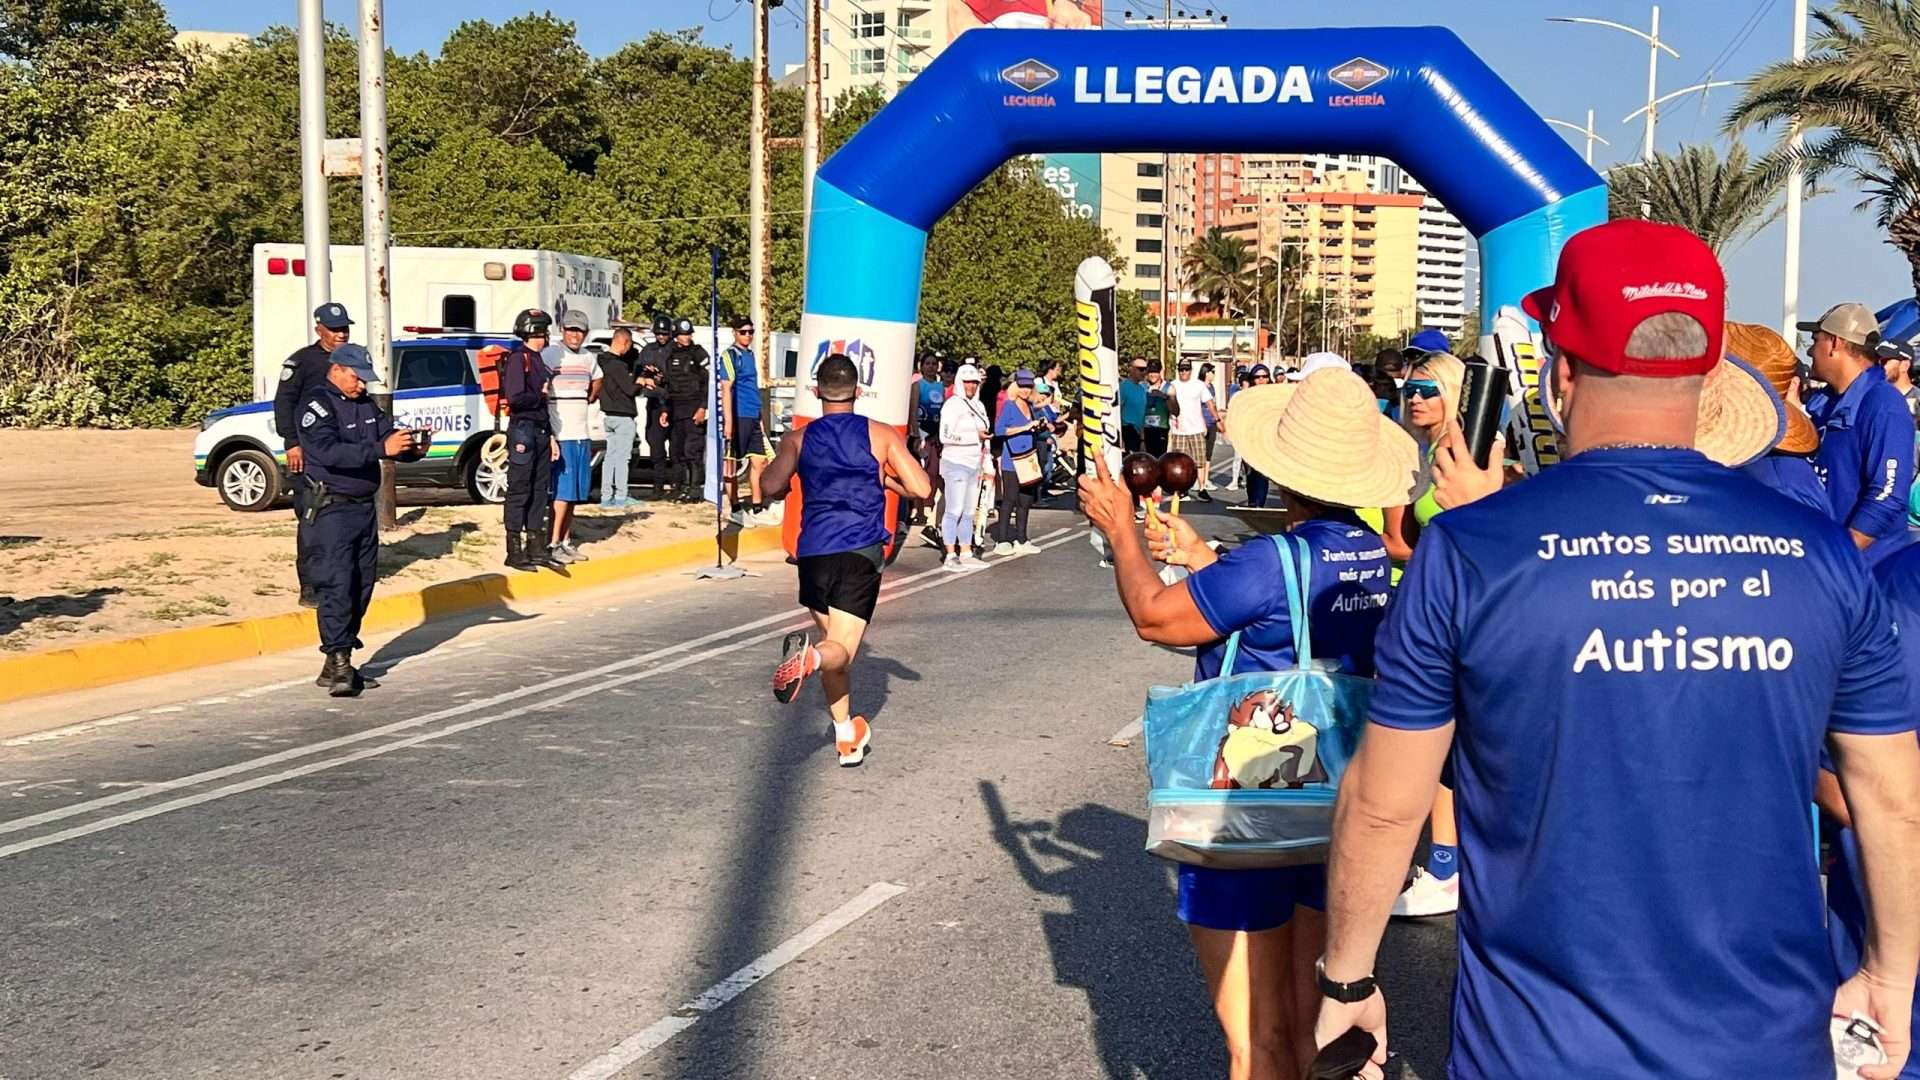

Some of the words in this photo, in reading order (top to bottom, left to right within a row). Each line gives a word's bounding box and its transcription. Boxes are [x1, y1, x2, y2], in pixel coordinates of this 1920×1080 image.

[1074, 65, 1314, 104] LLEGADA
[1003, 93, 1056, 107] LECHERÍA
[1328, 92, 1385, 107] LECHERÍA
[414, 406, 440, 416] UNIDAD
[442, 405, 453, 415] DE
[414, 414, 472, 432] DRONES
[1537, 531, 1651, 560] Juntos
[1667, 534, 1805, 558] sumamos
[1322, 549, 1357, 562] Juntos
[1591, 570, 1655, 600] más
[1670, 577, 1727, 607] por
[1742, 569, 1771, 597] el
[1330, 592, 1388, 612] Autismo
[1572, 626, 1793, 673] Autismo
